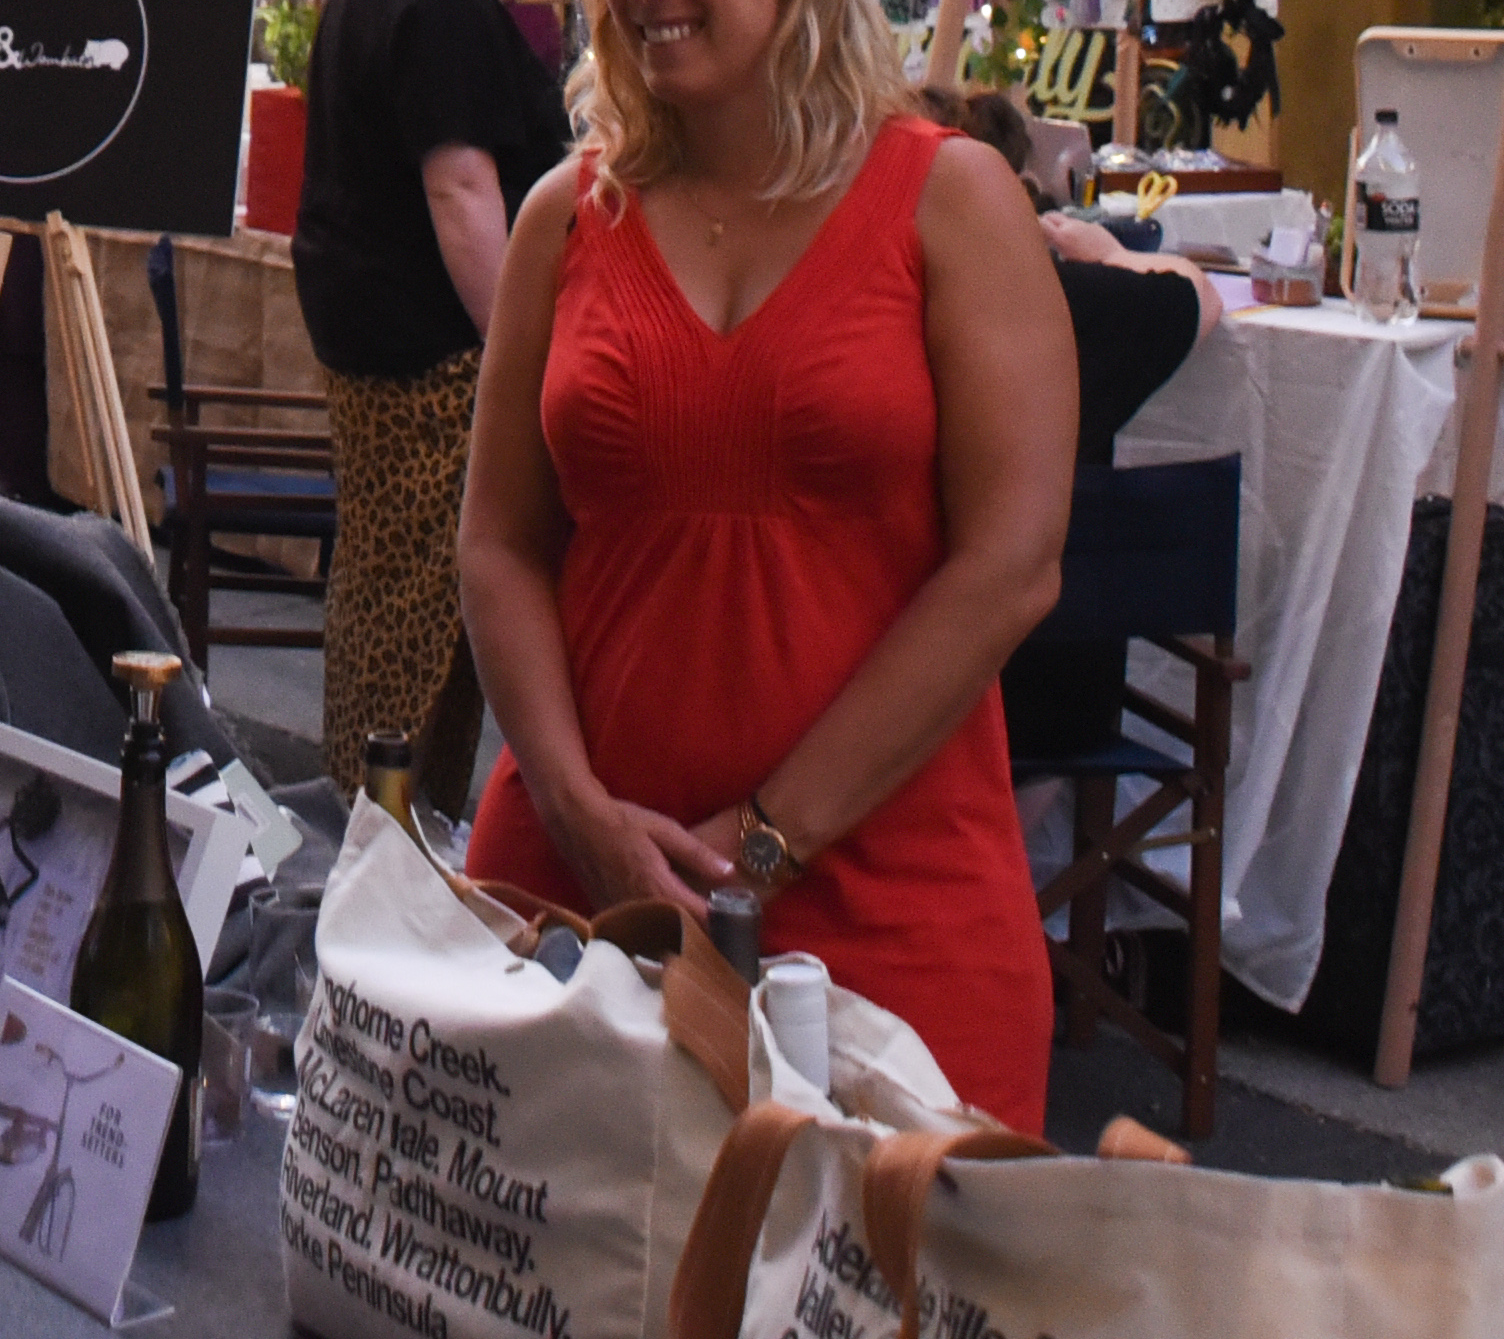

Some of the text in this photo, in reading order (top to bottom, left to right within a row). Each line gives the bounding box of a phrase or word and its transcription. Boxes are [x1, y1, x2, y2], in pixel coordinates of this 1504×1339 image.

[409, 1018, 511, 1097] Creek.
[403, 1068, 500, 1148] Coast.
[371, 1151, 535, 1275] Padthaway.
[447, 1138, 547, 1223] Mount
[379, 1212, 572, 1339] Wrattonbully.
